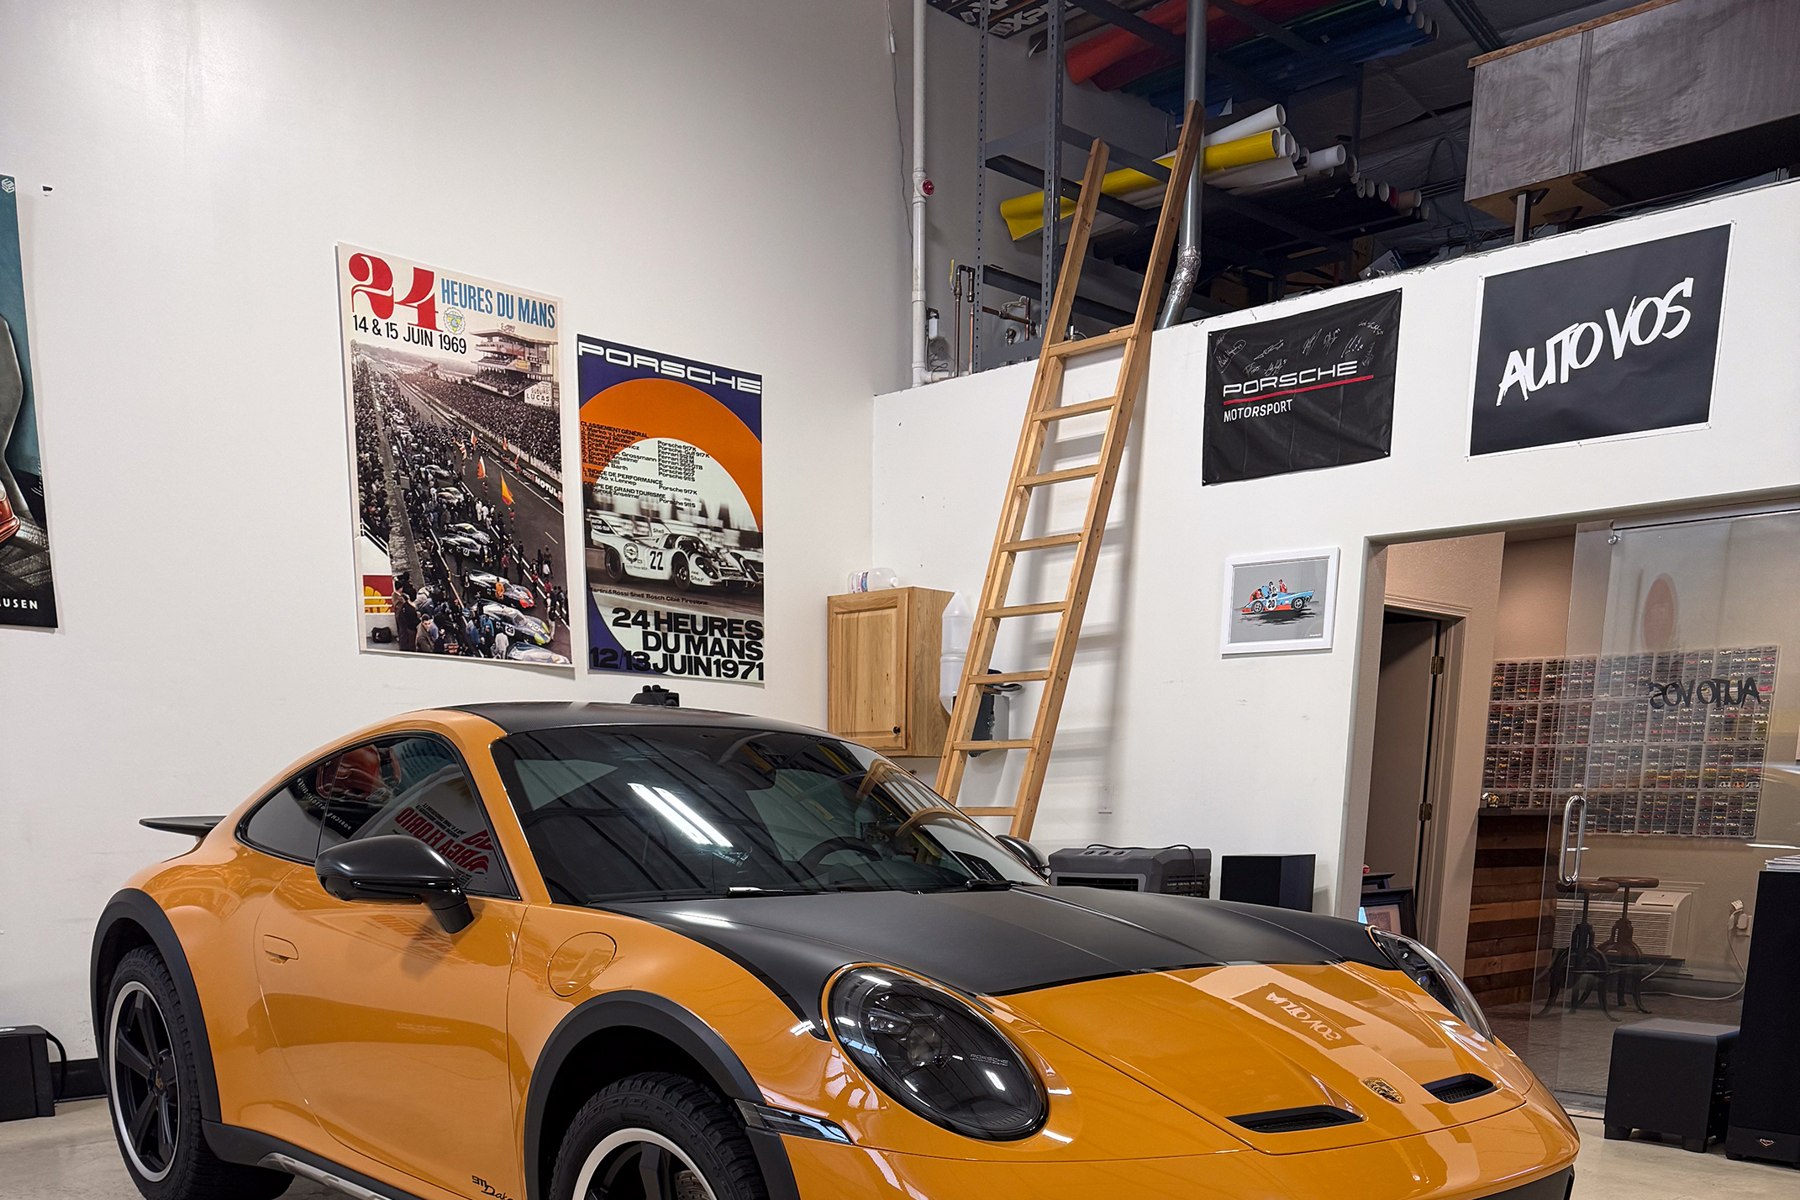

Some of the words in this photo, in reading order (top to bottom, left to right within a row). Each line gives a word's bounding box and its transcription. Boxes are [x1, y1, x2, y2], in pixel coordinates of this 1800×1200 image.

[349, 252, 443, 332] 24
[441, 277, 493, 315] HEURES
[496, 291, 514, 320] DU
[518, 297, 556, 329] MANS
[352, 314, 369, 333] 14
[371, 319, 382, 336] &
[384, 321, 399, 340] 15
[403, 325, 433, 348] JUIN
[438, 332, 467, 355] 1969
[1496, 321, 1604, 406] AUTO
[1605, 277, 1694, 360] VOS
[578, 341, 761, 395] PORSCHE
[1223, 360, 1358, 398] PORSCHE
[526, 393, 550, 402] LUCAS
[1223, 398, 1293, 423] MOTORSPORT
[657, 440, 681, 449] Porsche
[621, 451, 656, 462] Grossmann
[658, 462, 682, 471] Porsche
[617, 473, 662, 485] PERFORMANCE
[658, 466, 682, 475] Porsche
[658, 471, 682, 480] Porsche
[535, 476, 558, 498] MOTUL
[613, 485, 635, 493] GRAND
[658, 484, 682, 493] Porsche
[649, 551, 664, 571] 22
[0, 599, 39, 610] USEN
[612, 607, 650, 630] 24
[654, 610, 764, 641] HEURES
[642, 631, 680, 654] DU
[685, 635, 764, 660] MANS
[652, 652, 712, 678] JUIN
[713, 658, 764, 681] 1971
